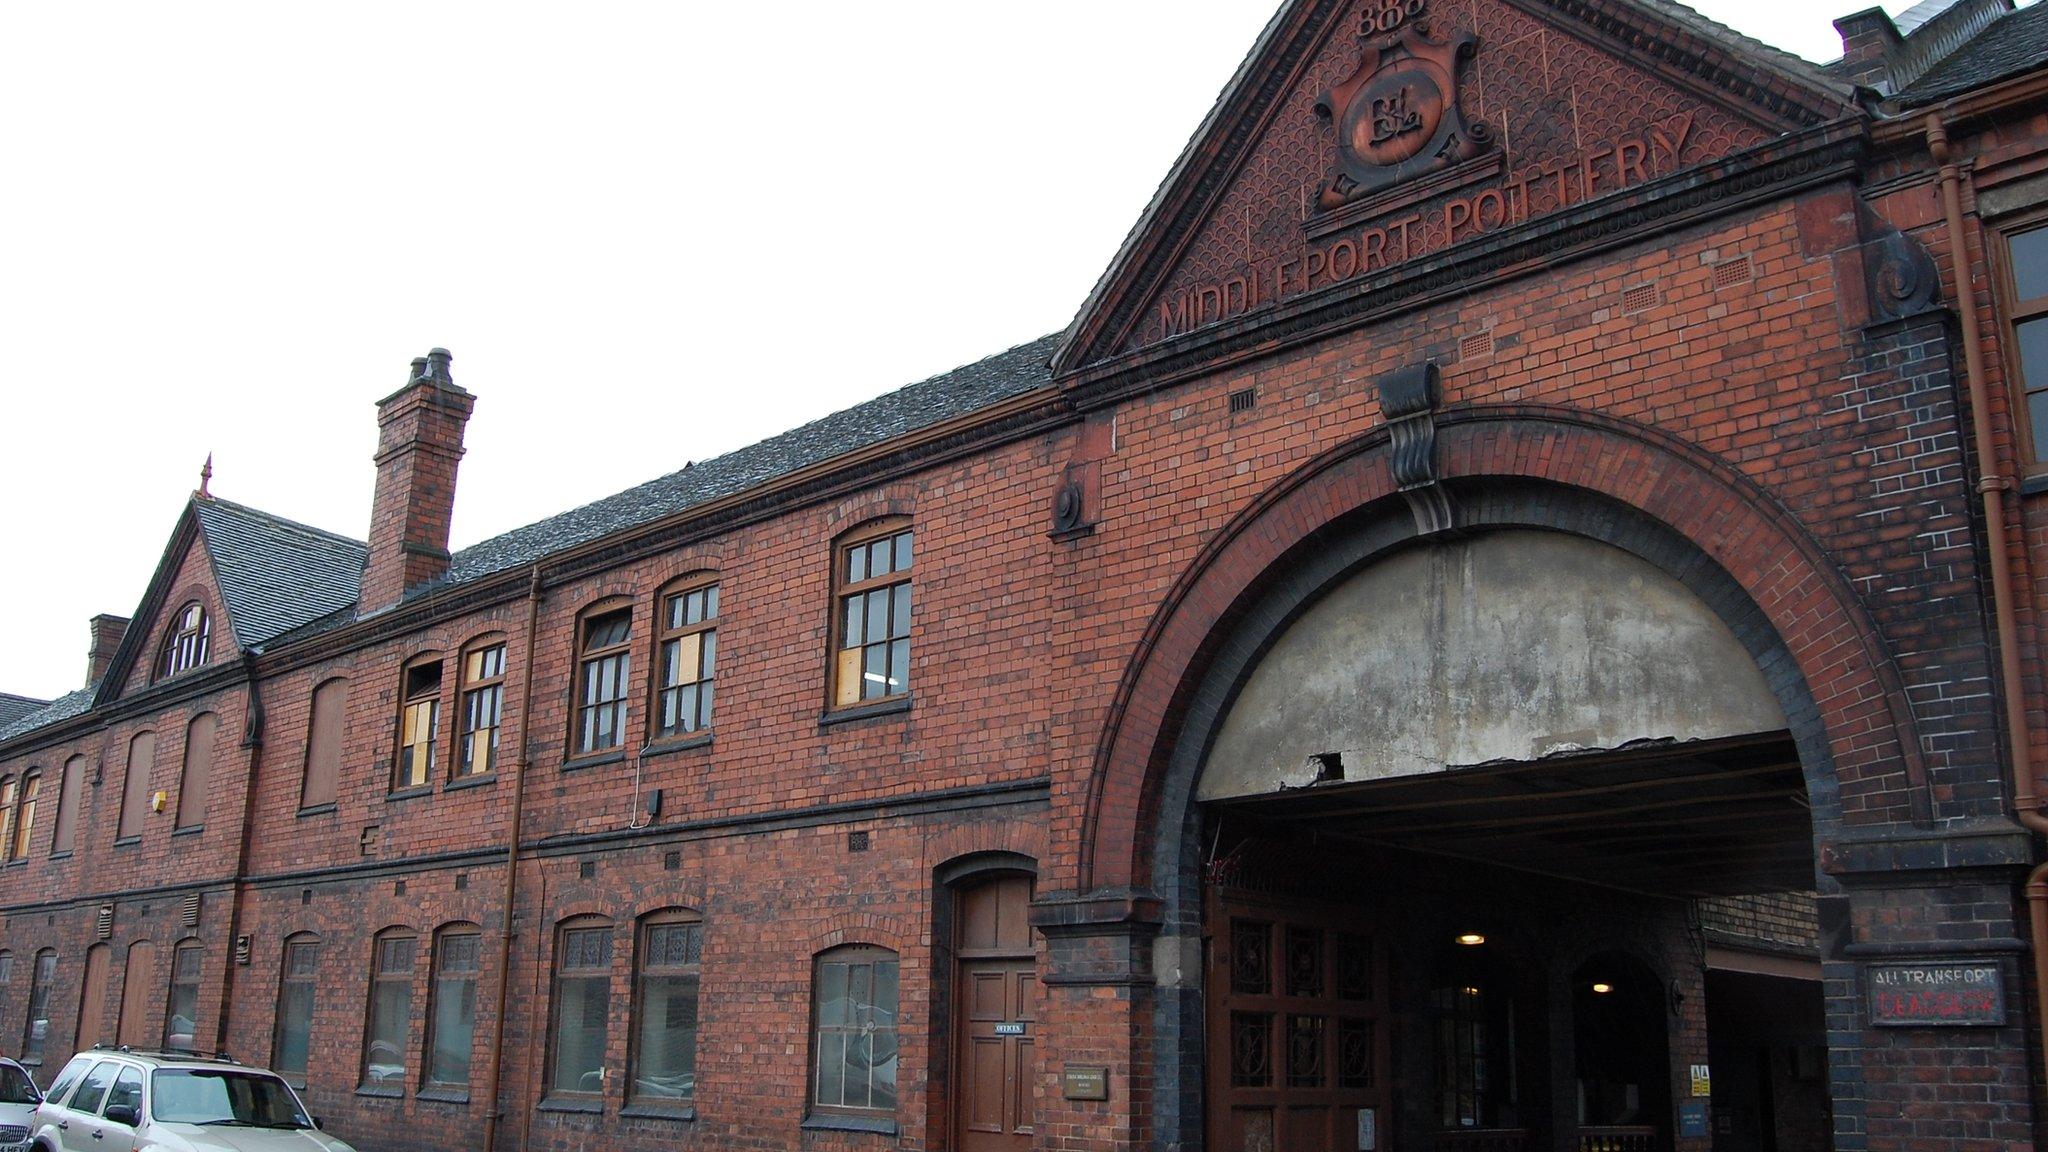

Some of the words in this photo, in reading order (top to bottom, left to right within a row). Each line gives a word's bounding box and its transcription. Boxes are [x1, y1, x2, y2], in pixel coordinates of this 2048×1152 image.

[1160, 213, 1420, 338] MIDDLEPORT
[1444, 110, 1692, 244] POTTERY
[1876, 970, 1899, 985] ALL
[1902, 968, 1996, 984] TRANSPORT
